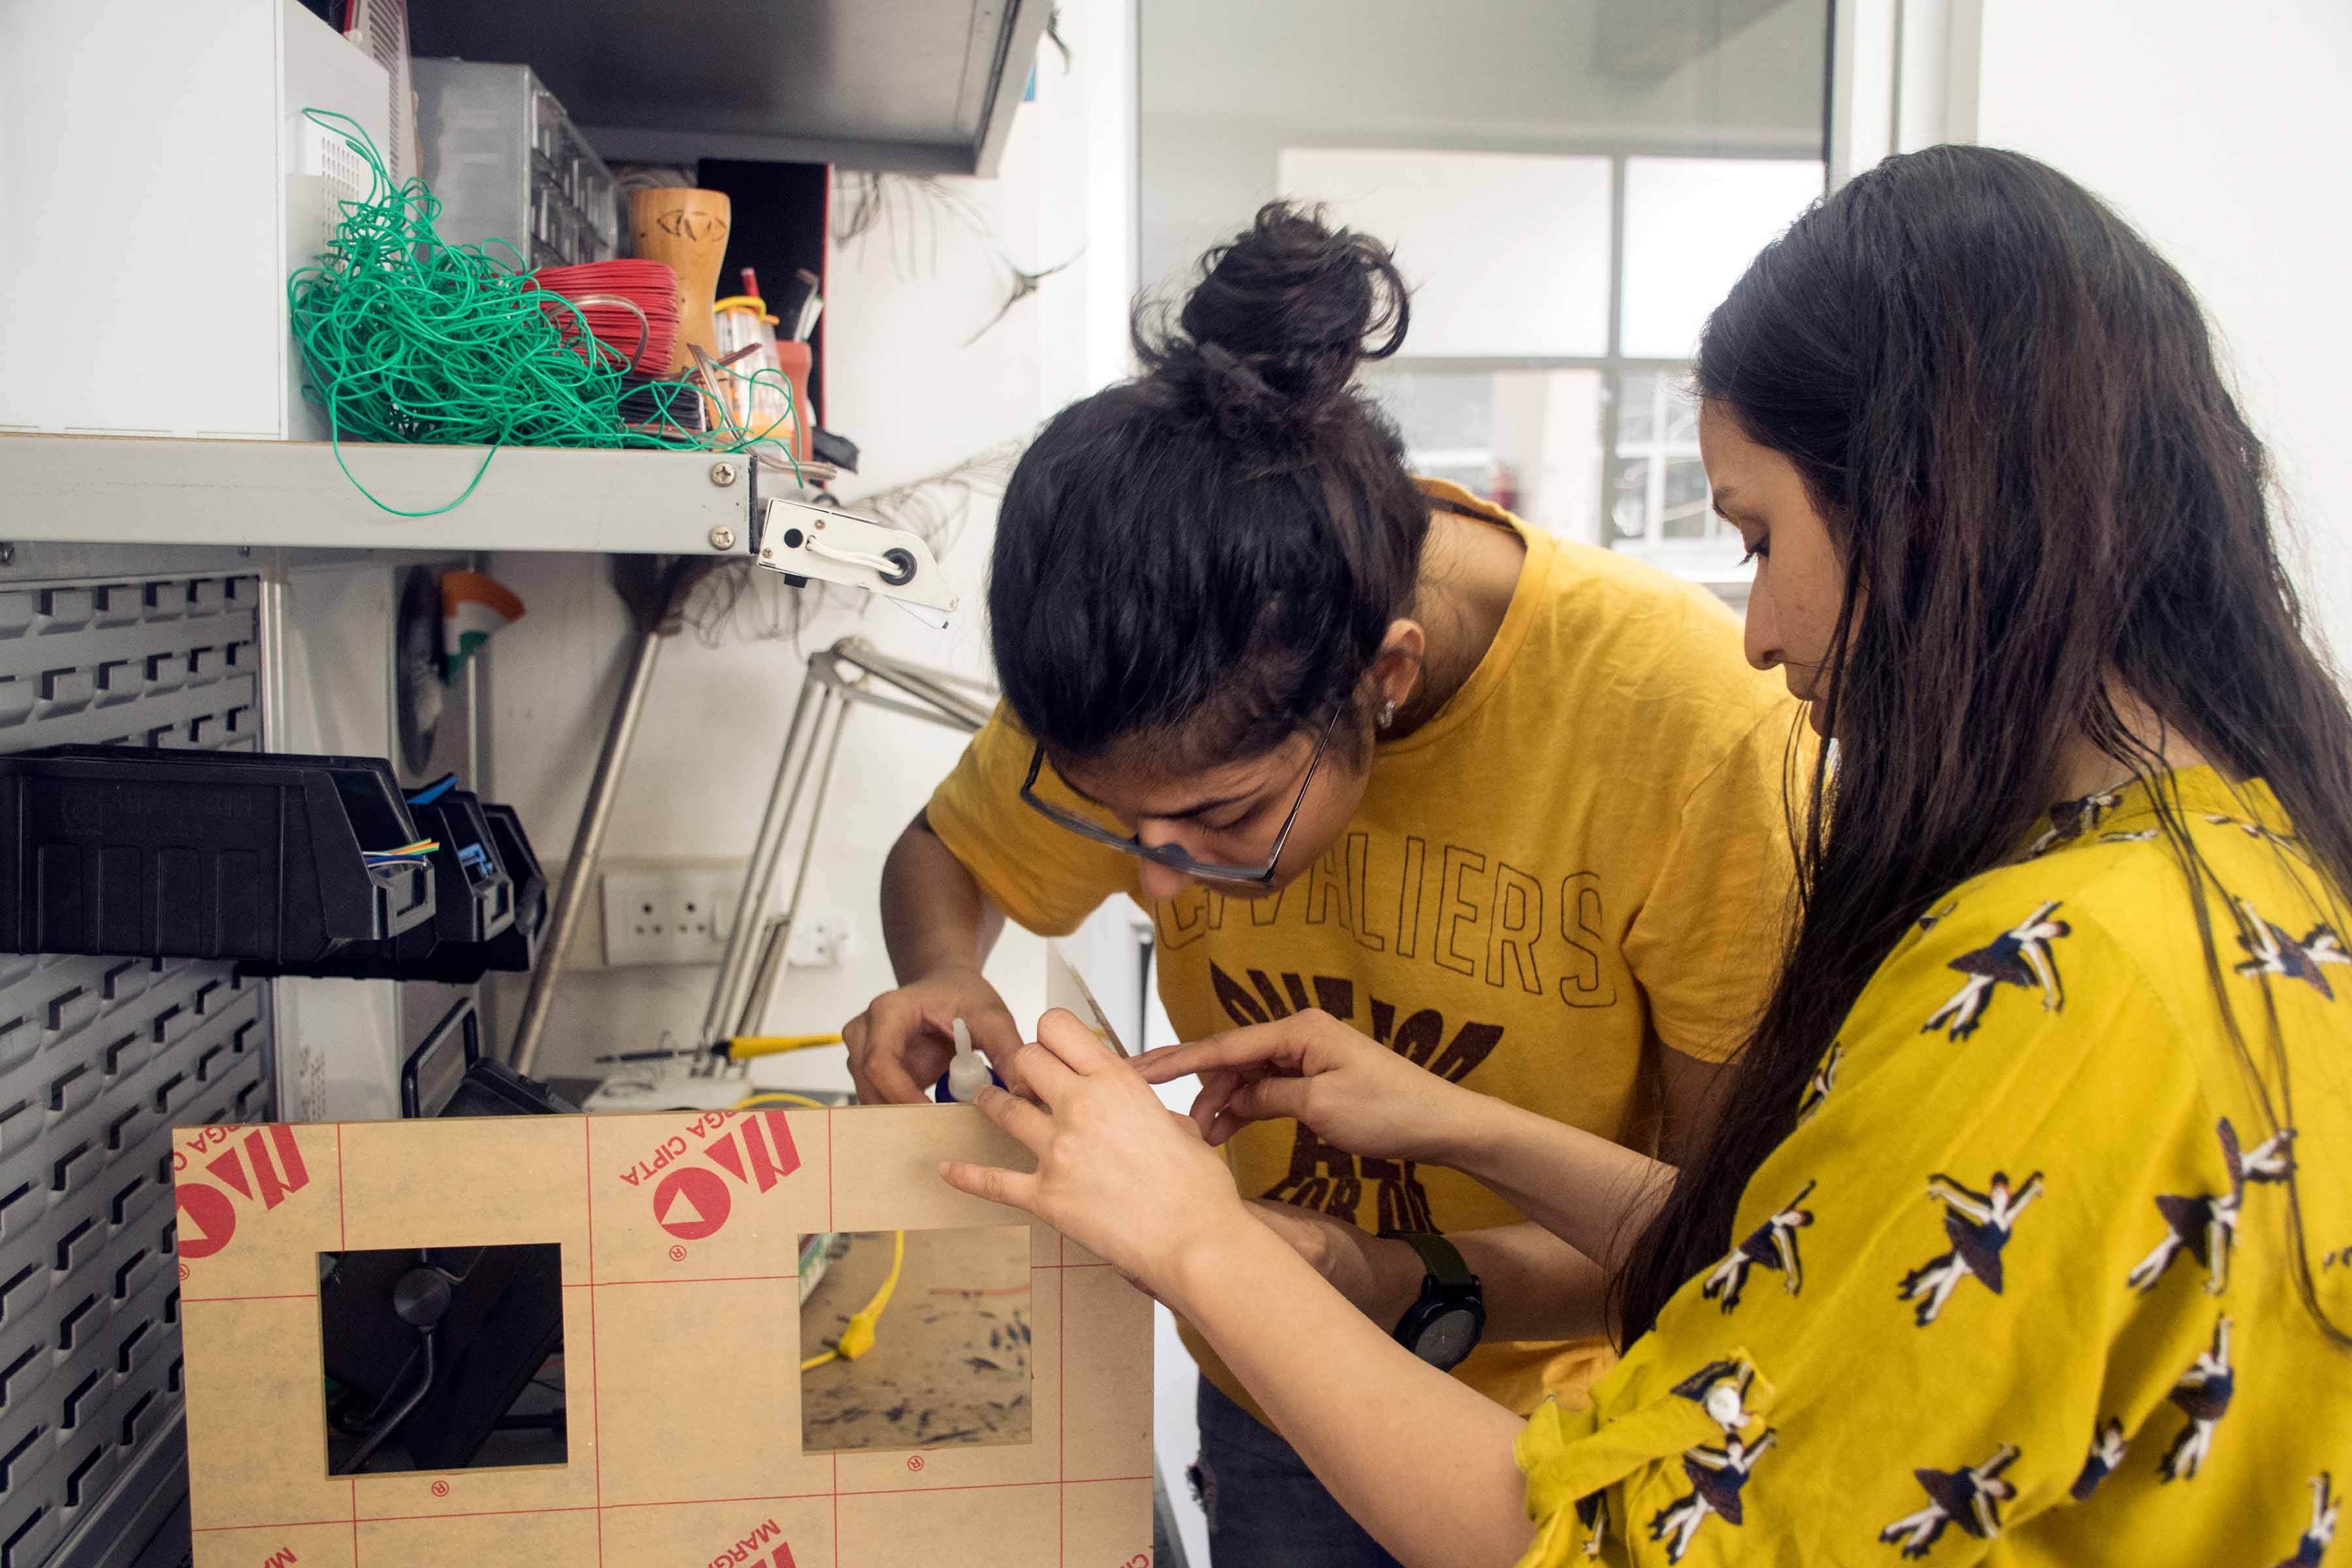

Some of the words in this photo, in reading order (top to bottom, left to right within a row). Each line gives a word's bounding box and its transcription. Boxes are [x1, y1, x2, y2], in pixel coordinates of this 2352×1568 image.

[1155, 831, 1618, 1008] ALIERS
[619, 1136, 687, 1186] CIPTA
[708, 1518, 781, 1568] MARG
